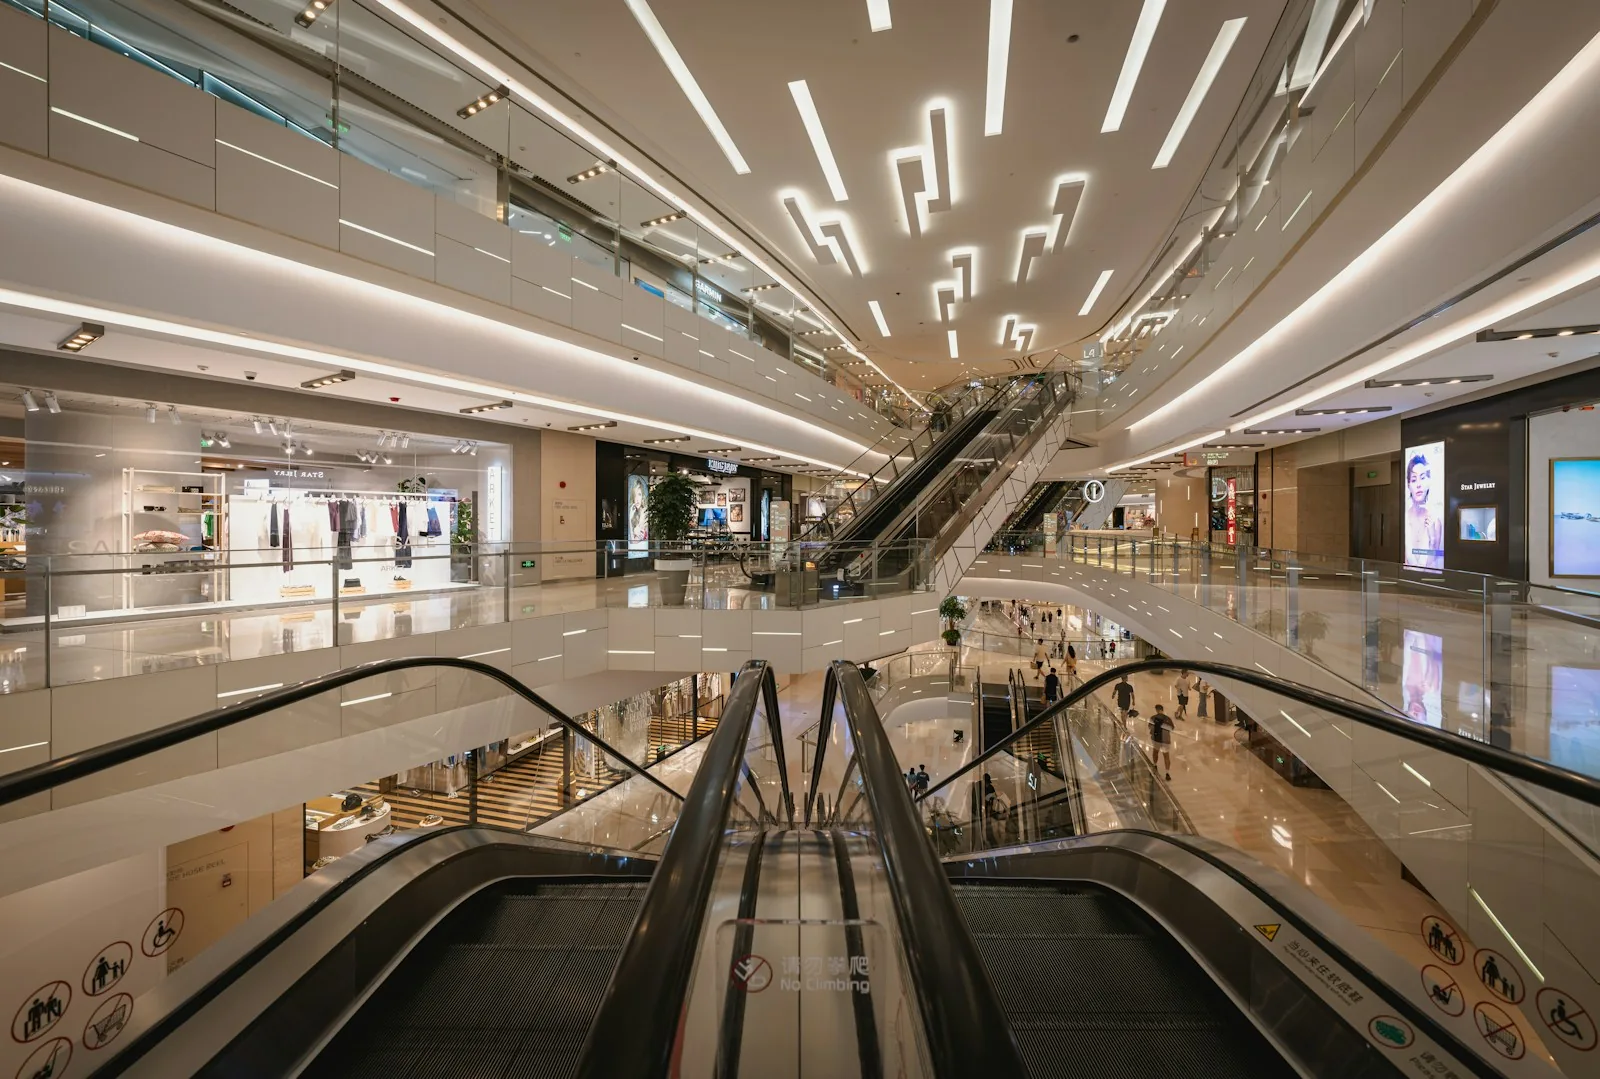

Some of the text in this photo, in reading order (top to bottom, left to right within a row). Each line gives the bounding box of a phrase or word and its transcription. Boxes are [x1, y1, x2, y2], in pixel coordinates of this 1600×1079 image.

[696, 279, 722, 303] GARMIN
[780, 977, 870, 994] No Climbing
